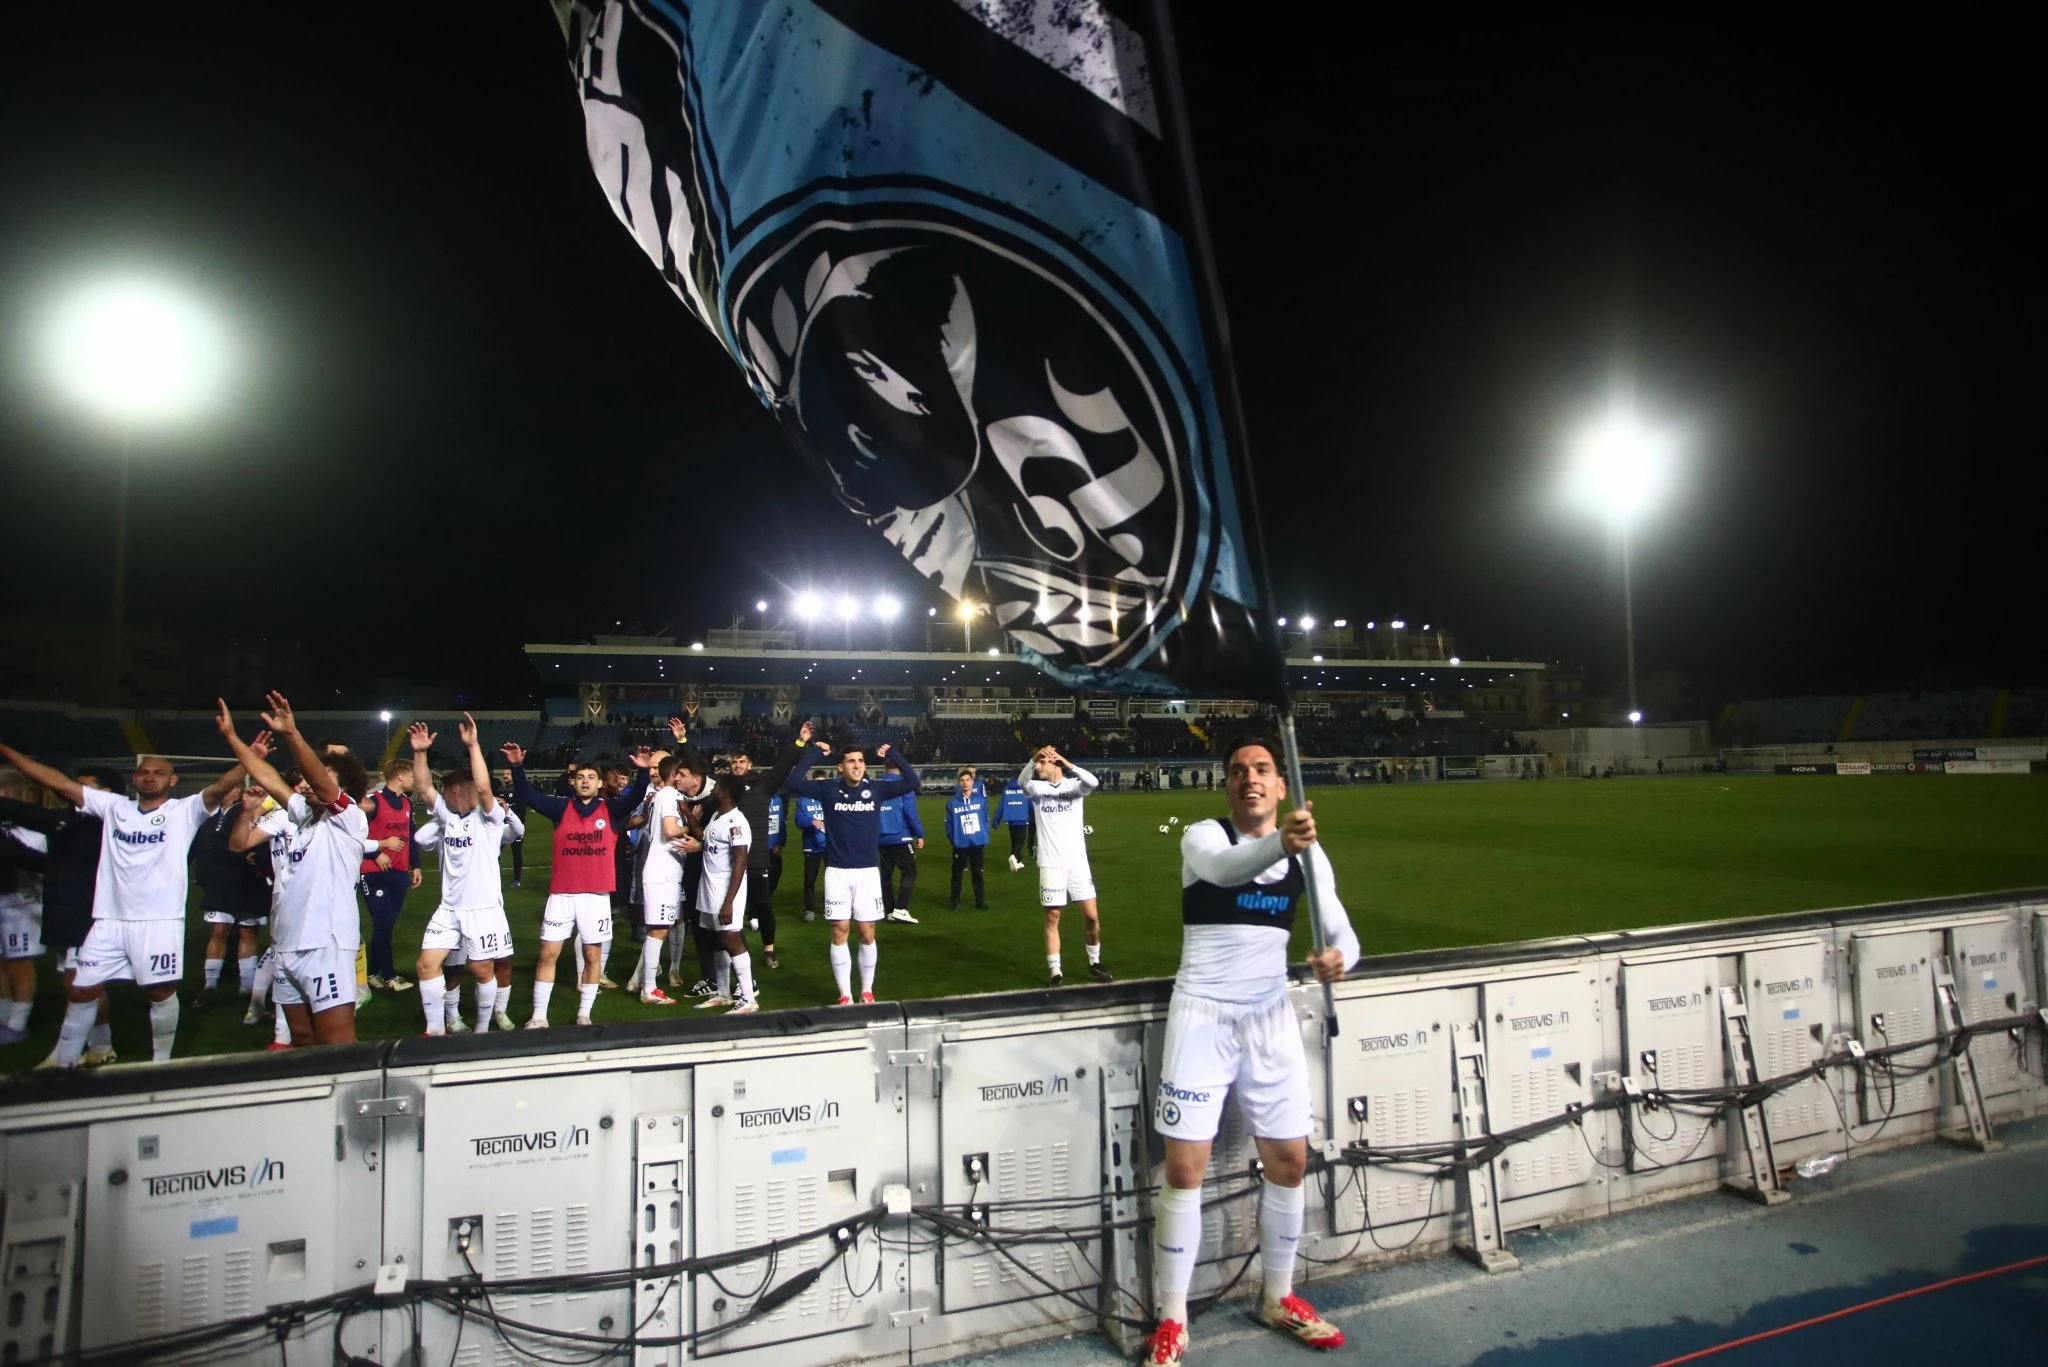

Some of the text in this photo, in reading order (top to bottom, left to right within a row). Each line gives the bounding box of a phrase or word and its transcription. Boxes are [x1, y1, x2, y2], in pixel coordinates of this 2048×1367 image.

[834, 801, 875, 811] novibet
[567, 830, 603, 841] capelli
[562, 845, 607, 856] novibet
[598, 918, 610, 932] 27
[9, 933, 18, 948] 8
[480, 933, 494, 950] 12
[151, 953, 171, 971] 70
[313, 976, 323, 997] 7
